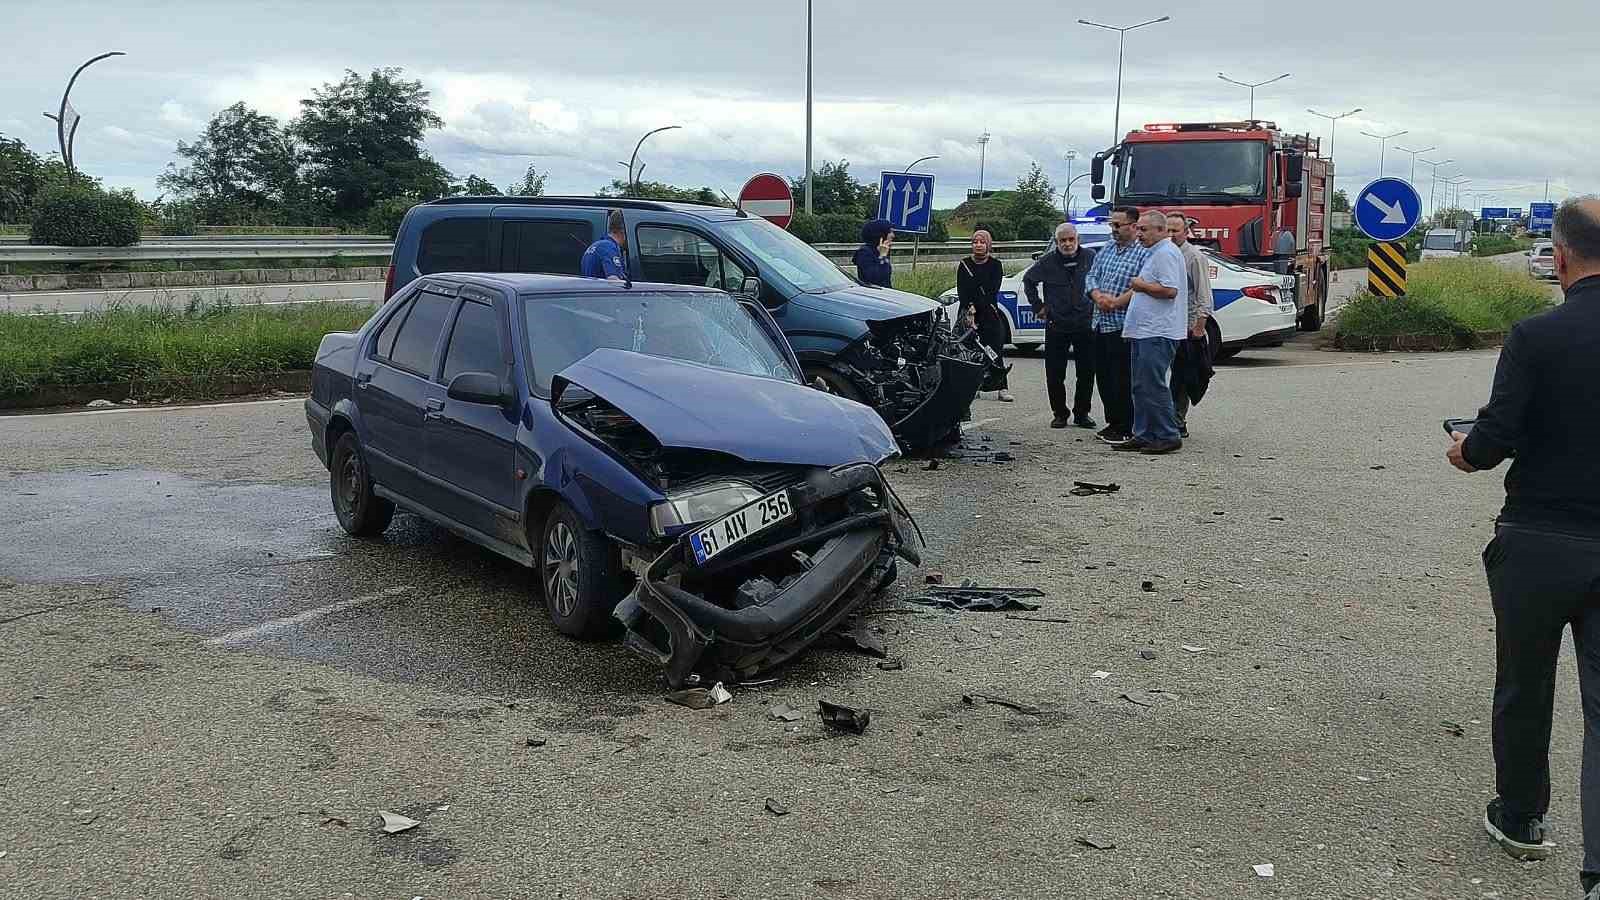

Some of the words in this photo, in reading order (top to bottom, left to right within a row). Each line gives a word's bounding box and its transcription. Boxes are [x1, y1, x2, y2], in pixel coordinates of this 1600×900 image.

[1021, 311, 1042, 324] TRA
[701, 529, 719, 555] 61
[725, 511, 748, 543] AIV
[758, 494, 788, 525] 256
